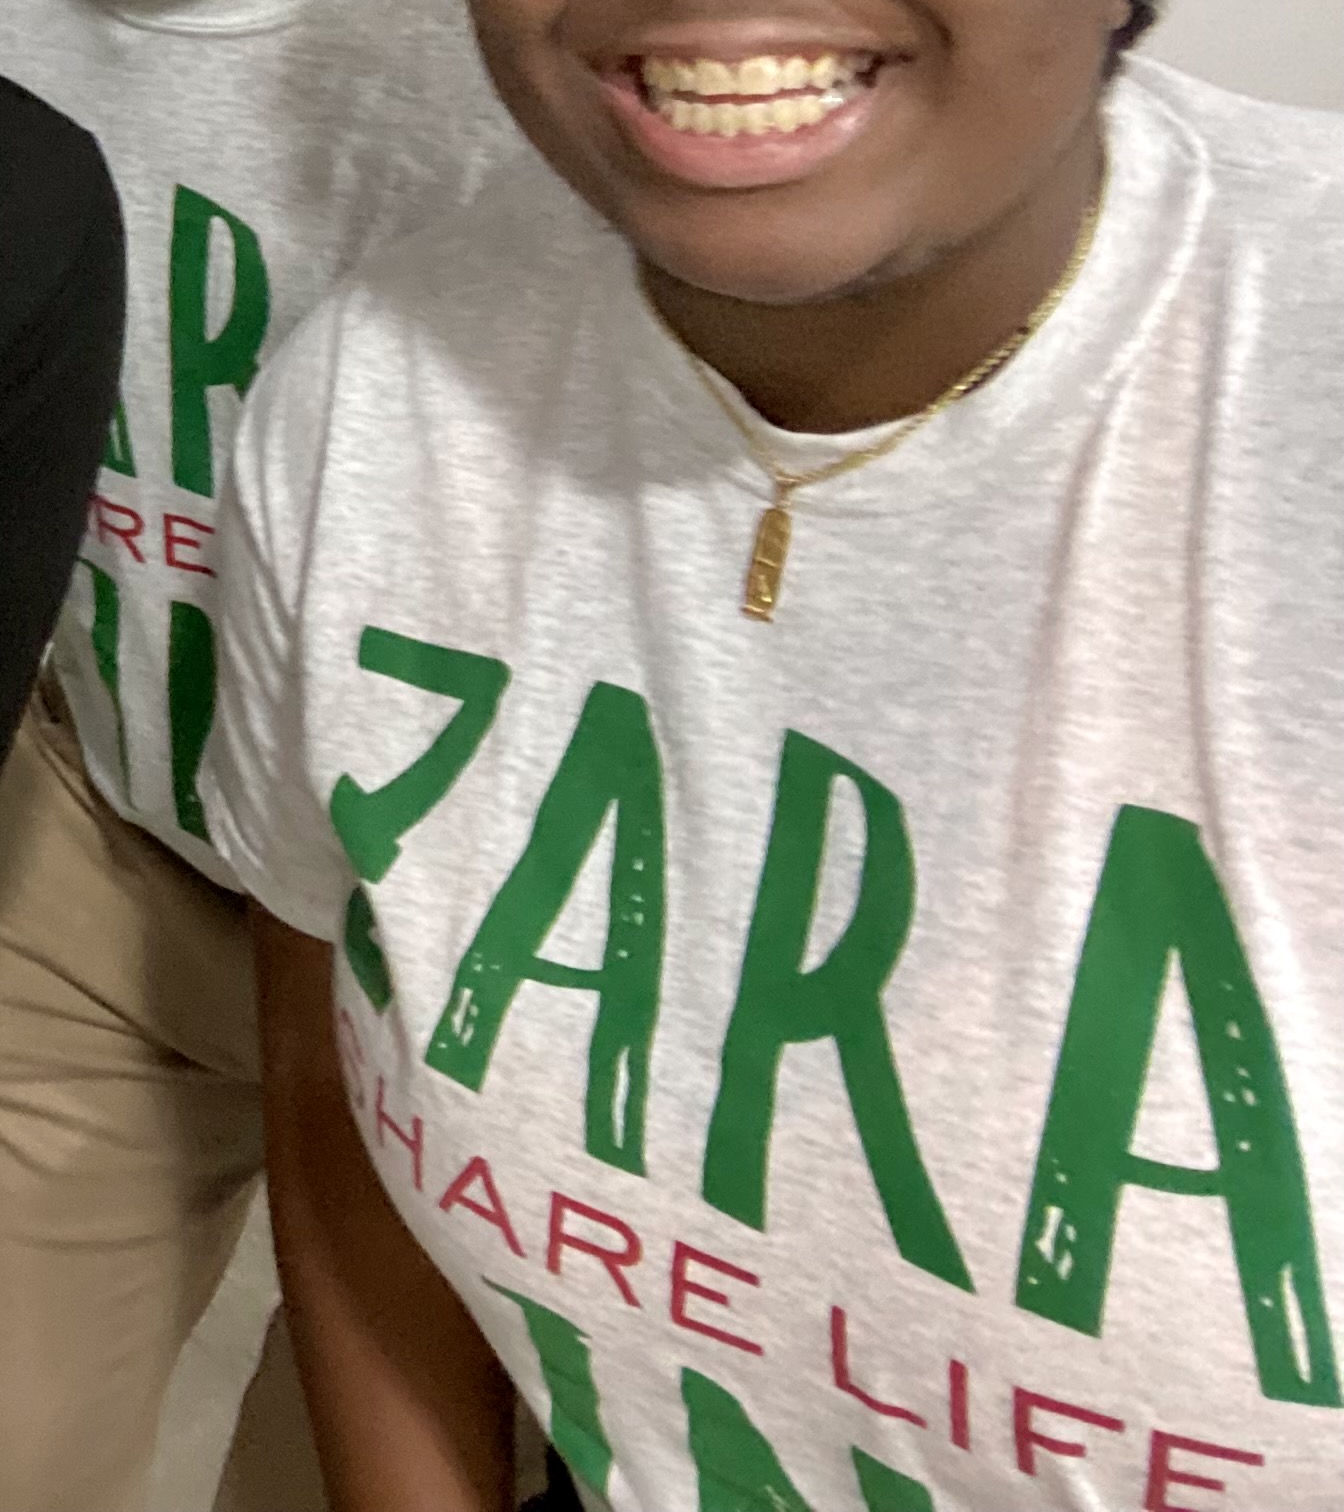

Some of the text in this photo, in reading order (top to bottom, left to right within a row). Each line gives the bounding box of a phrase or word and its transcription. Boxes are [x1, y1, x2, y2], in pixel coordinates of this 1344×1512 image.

[330, 624, 1344, 1410] ZARA
[336, 1008, 766, 1358] SHARE
[830, 1304, 1265, 1512] LIFE
